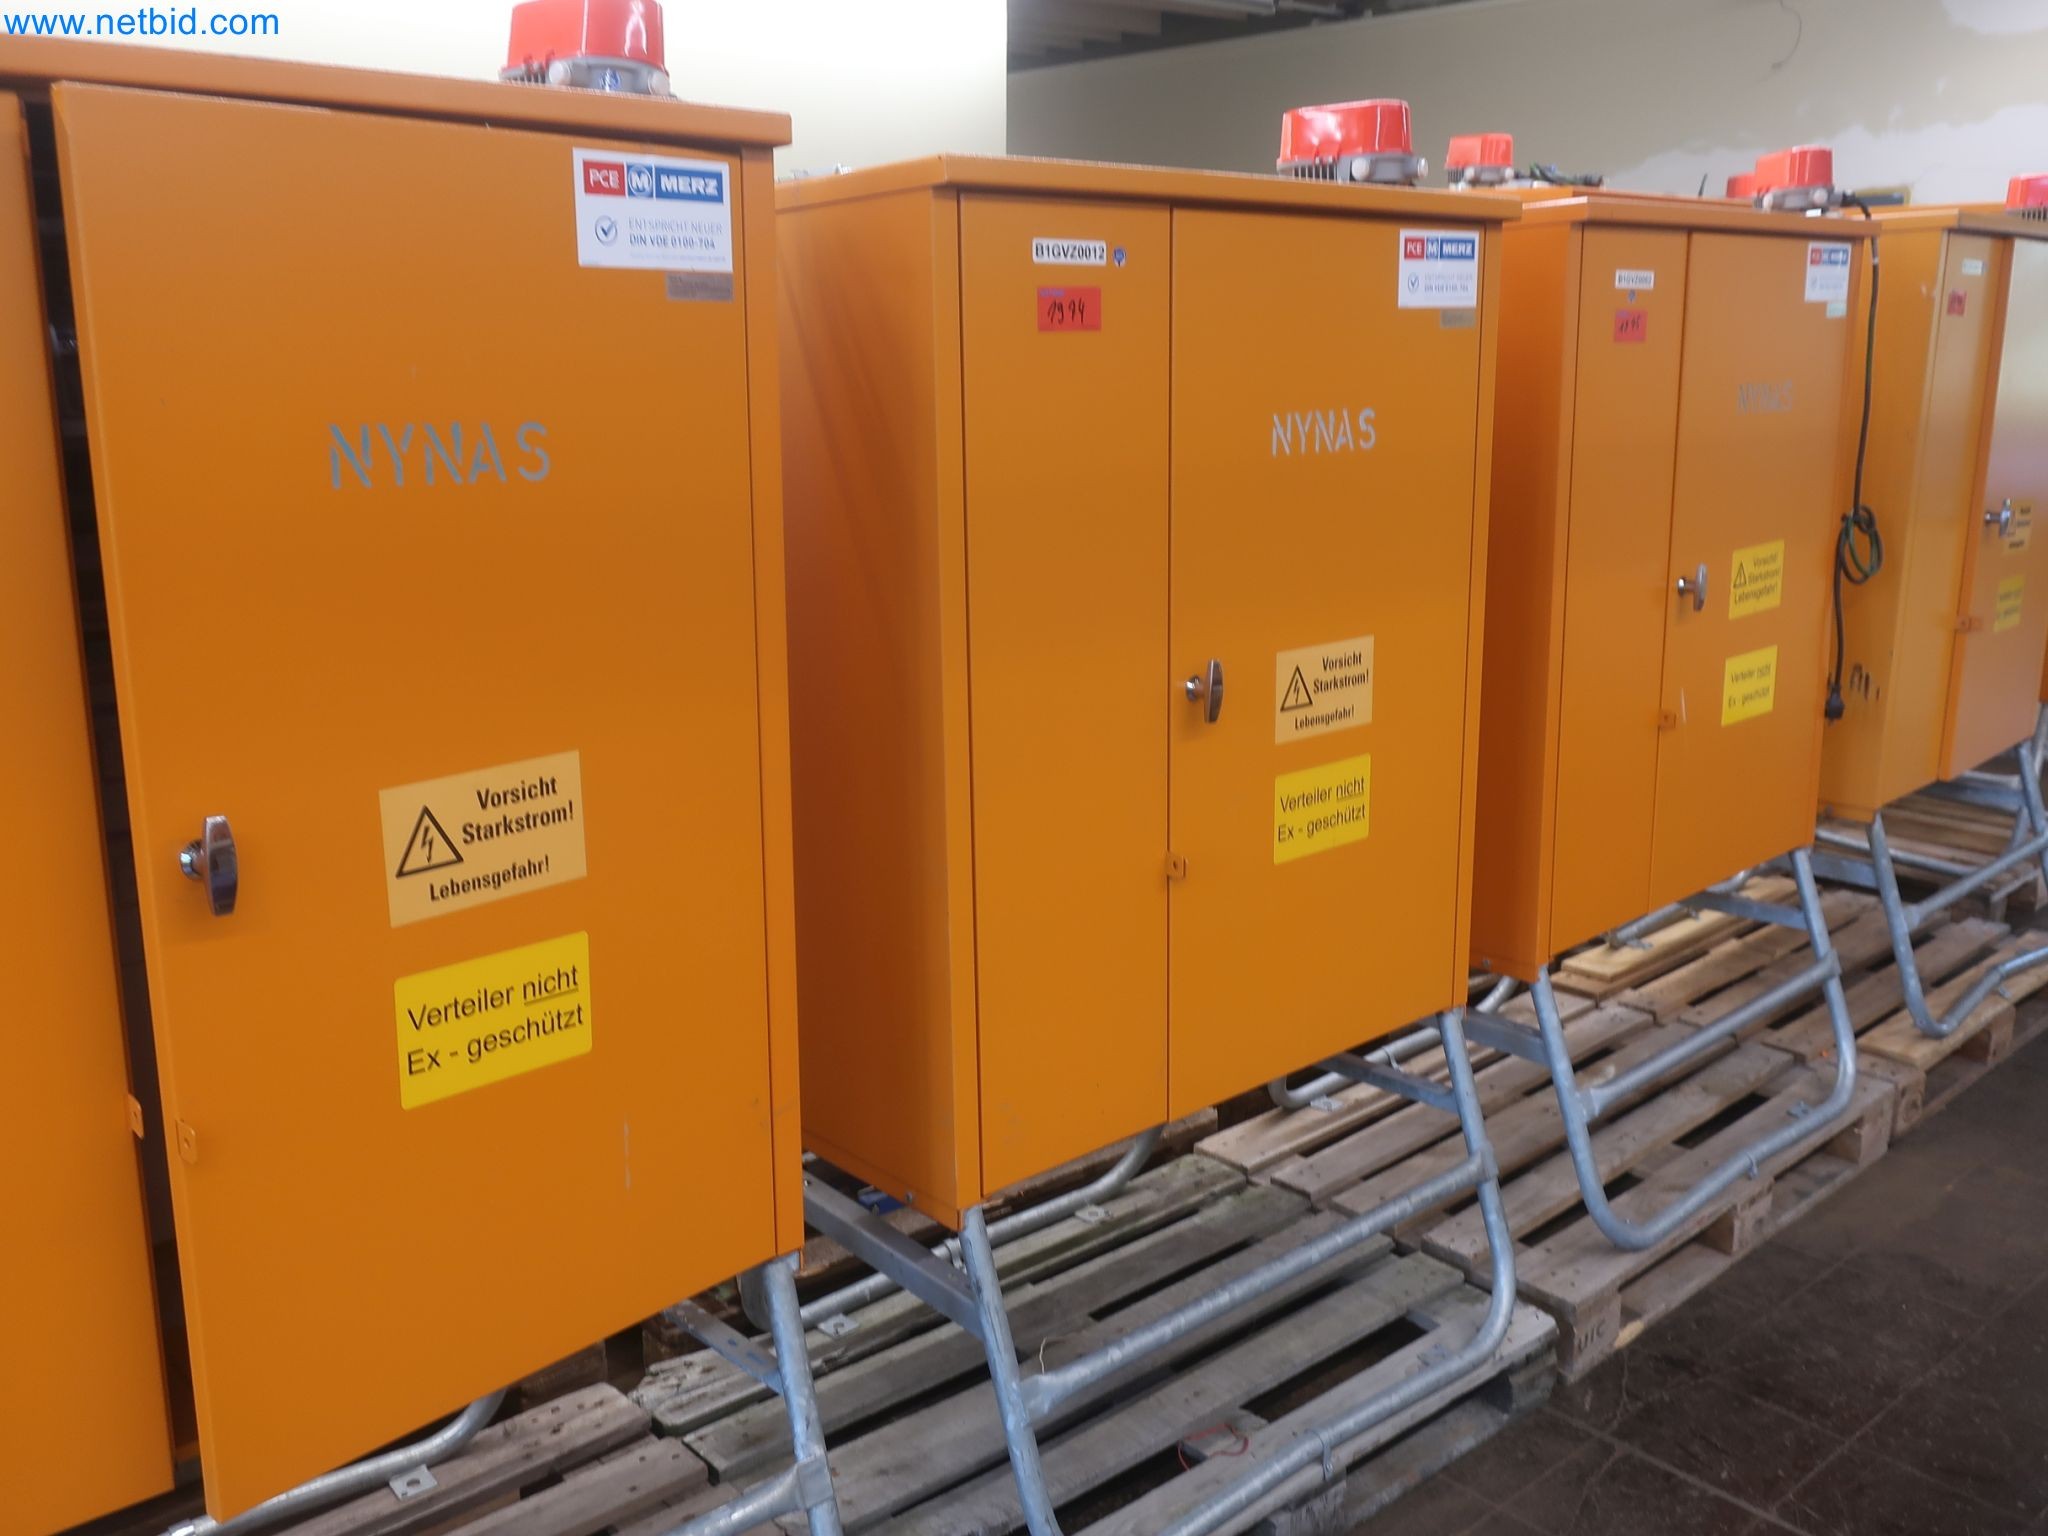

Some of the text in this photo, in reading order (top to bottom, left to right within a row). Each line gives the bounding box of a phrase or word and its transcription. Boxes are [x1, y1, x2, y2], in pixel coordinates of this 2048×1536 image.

[588, 168, 620, 189] PCE
[660, 174, 718, 196] MERZ
[630, 234, 716, 250] DIN VDE 0100-704
[691, 220, 723, 235] NEUER
[1034, 243, 1105, 260] B1GVZ0012
[1442, 242, 1473, 257] MERZ
[1272, 407, 1376, 457] NYNAS
[328, 420, 551, 490] NYNAS
[1322, 651, 1362, 672] Vorsicht
[1313, 668, 1369, 694] Starkstrom!
[1294, 704, 1355, 730] Lebensgefahr!
[476, 776, 558, 810] Vorsicht
[1280, 776, 1365, 813] Verteiler nicht
[462, 800, 574, 845] Starkstrom!
[1278, 823, 1294, 843] Ex
[1306, 803, 1366, 839] geschützt
[429, 854, 550, 902] Lebensgefahr!
[407, 965, 579, 1032] Verteiler nicht
[407, 1048, 440, 1076] Ex
[467, 1003, 584, 1064] geschützt
